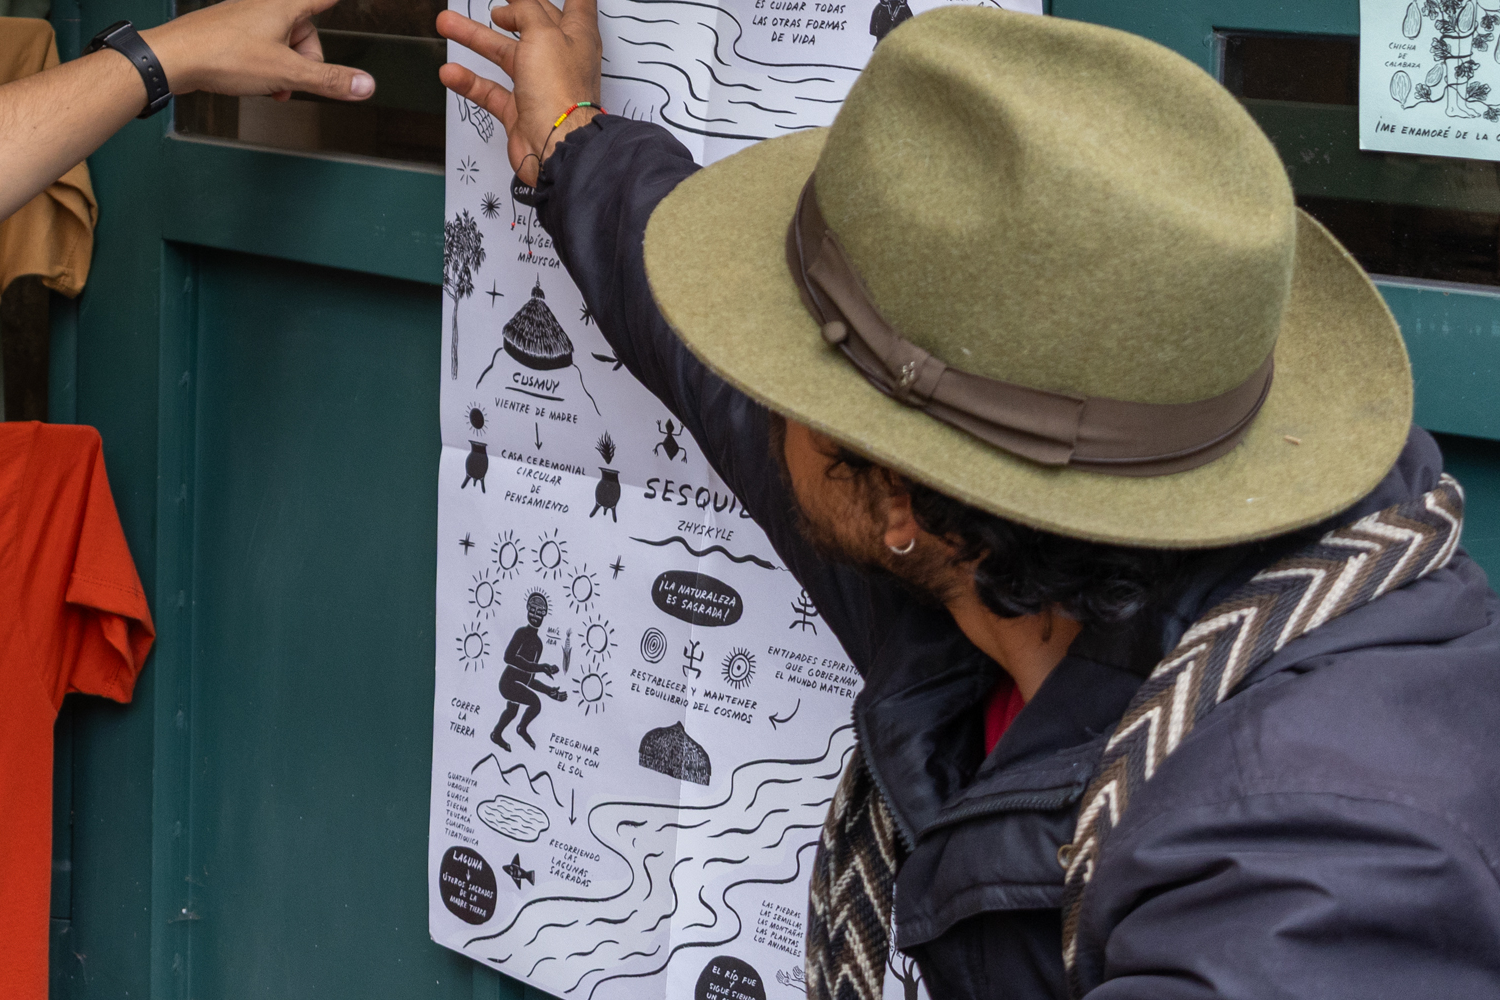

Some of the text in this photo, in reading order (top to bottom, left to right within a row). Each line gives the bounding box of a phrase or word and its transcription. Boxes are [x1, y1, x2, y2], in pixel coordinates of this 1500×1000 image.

[769, 0, 807, 12] CUIDAR
[814, 2, 846, 15] TODAS
[752, 14, 847, 31] LAS OTRAS FORMAS
[771, 31, 816, 46] DE VIDA
[1388, 42, 1417, 51] CHICHA
[1384, 61, 1421, 69] CALABAZA
[1375, 116, 1488, 141] ¡ME ENAMORÉ DE LA
[512, 372, 560, 394] CUSMUY
[494, 397, 578, 424] VIENTRE DE MADRE
[501, 449, 586, 476] CASA CEREMONIAL
[516, 466, 562, 486] CIRCULAR
[531, 484, 541, 494] DE
[504, 490, 570, 514] PENSAMIENTO
[677, 520, 734, 542] ZHYSKYLE
[658, 574, 737, 607] ¡LA NATURALEZA
[666, 595, 731, 622] ES SAGRADA!
[767, 646, 818, 666] ENTIDADES
[775, 670, 856, 700] EL MUNDO MATERI
[785, 662, 858, 688] QUE GOBIERNAN
[630, 669, 758, 710] RESTABLECER Y MANTENER
[451, 697, 481, 715] CORRER
[630, 683, 753, 724] EL EQUILIBRIO DEL COSMOS
[458, 712, 467, 722] LA
[450, 721, 475, 738] TIERRA
[550, 733, 600, 756] PEREGRINAR
[548, 745, 600, 769] JUNTO Y CON
[557, 761, 584, 778] EL SOL
[452, 850, 483, 871] LAGUNA
[549, 838, 601, 863] RECORRIENDO
[564, 852, 577, 863] LAS
[550, 868, 591, 888] SAGRADAS
[551, 857, 589, 878] LAGUNAS
